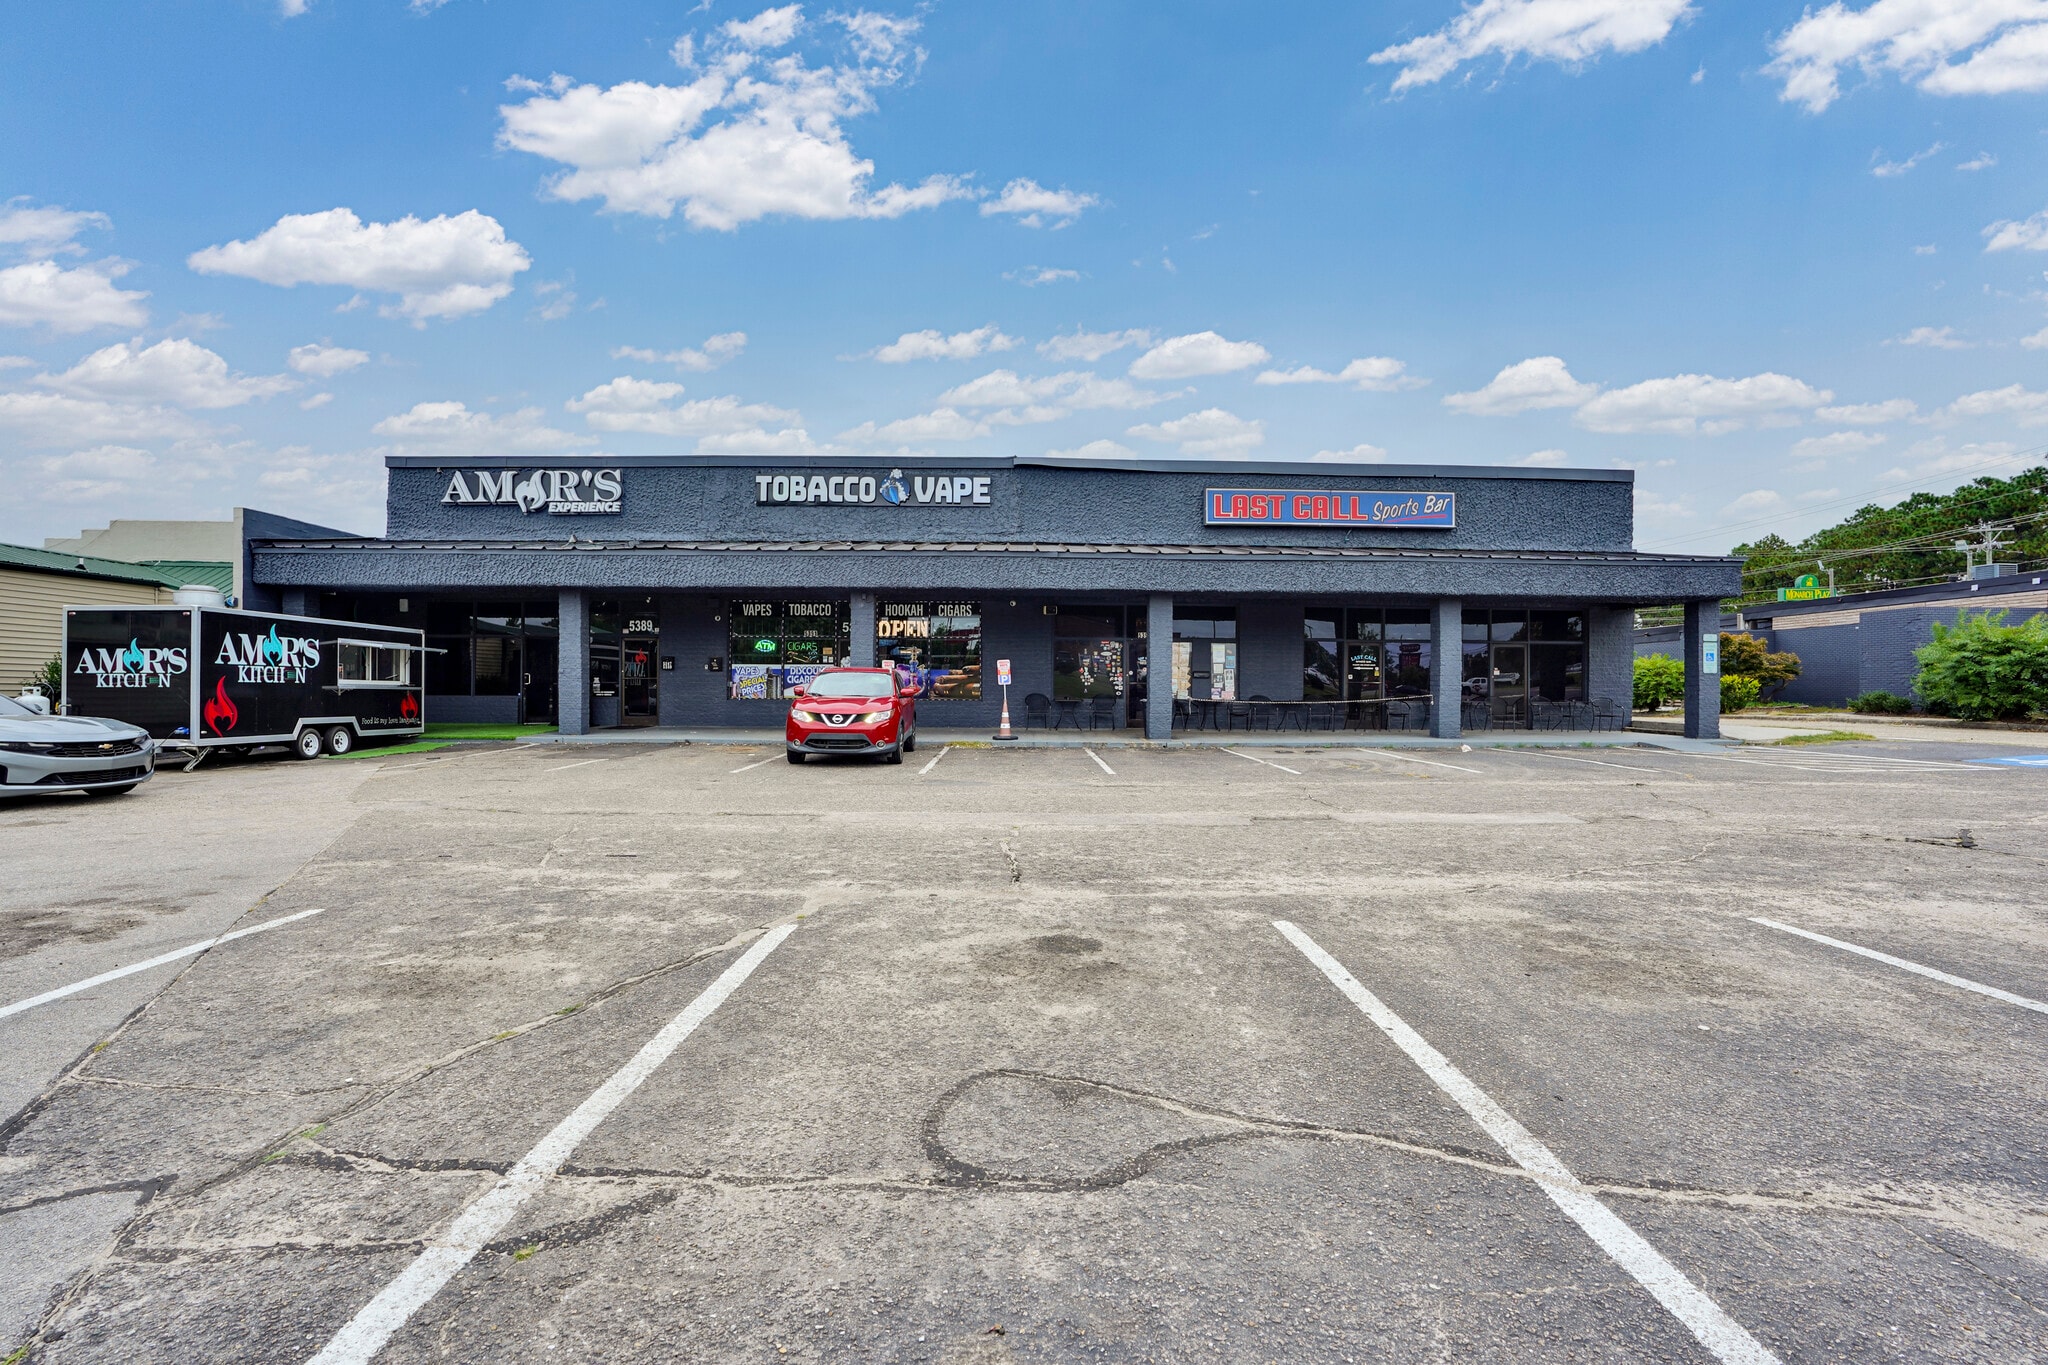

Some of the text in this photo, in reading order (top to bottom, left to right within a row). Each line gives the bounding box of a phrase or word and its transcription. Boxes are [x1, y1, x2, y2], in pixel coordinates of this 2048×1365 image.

[756, 475, 991, 504] TOBACCO VAPE
[548, 502, 622, 513] EXPERIENCE
[1213, 494, 1450, 523] LAST CALL Sports Bar
[1814, 588, 1831, 599] PLAZ
[742, 603, 772, 616] VAPES
[788, 603, 832, 616] TOBACCO
[885, 604, 924, 617] HOOKAH
[938, 604, 972, 617] CIGARS
[629, 620, 653, 632] 5389
[878, 618, 928, 637] OPEN
[754, 640, 776, 652] ATM
[787, 641, 818, 652] CIGARS
[735, 666, 760, 676] VAPES
